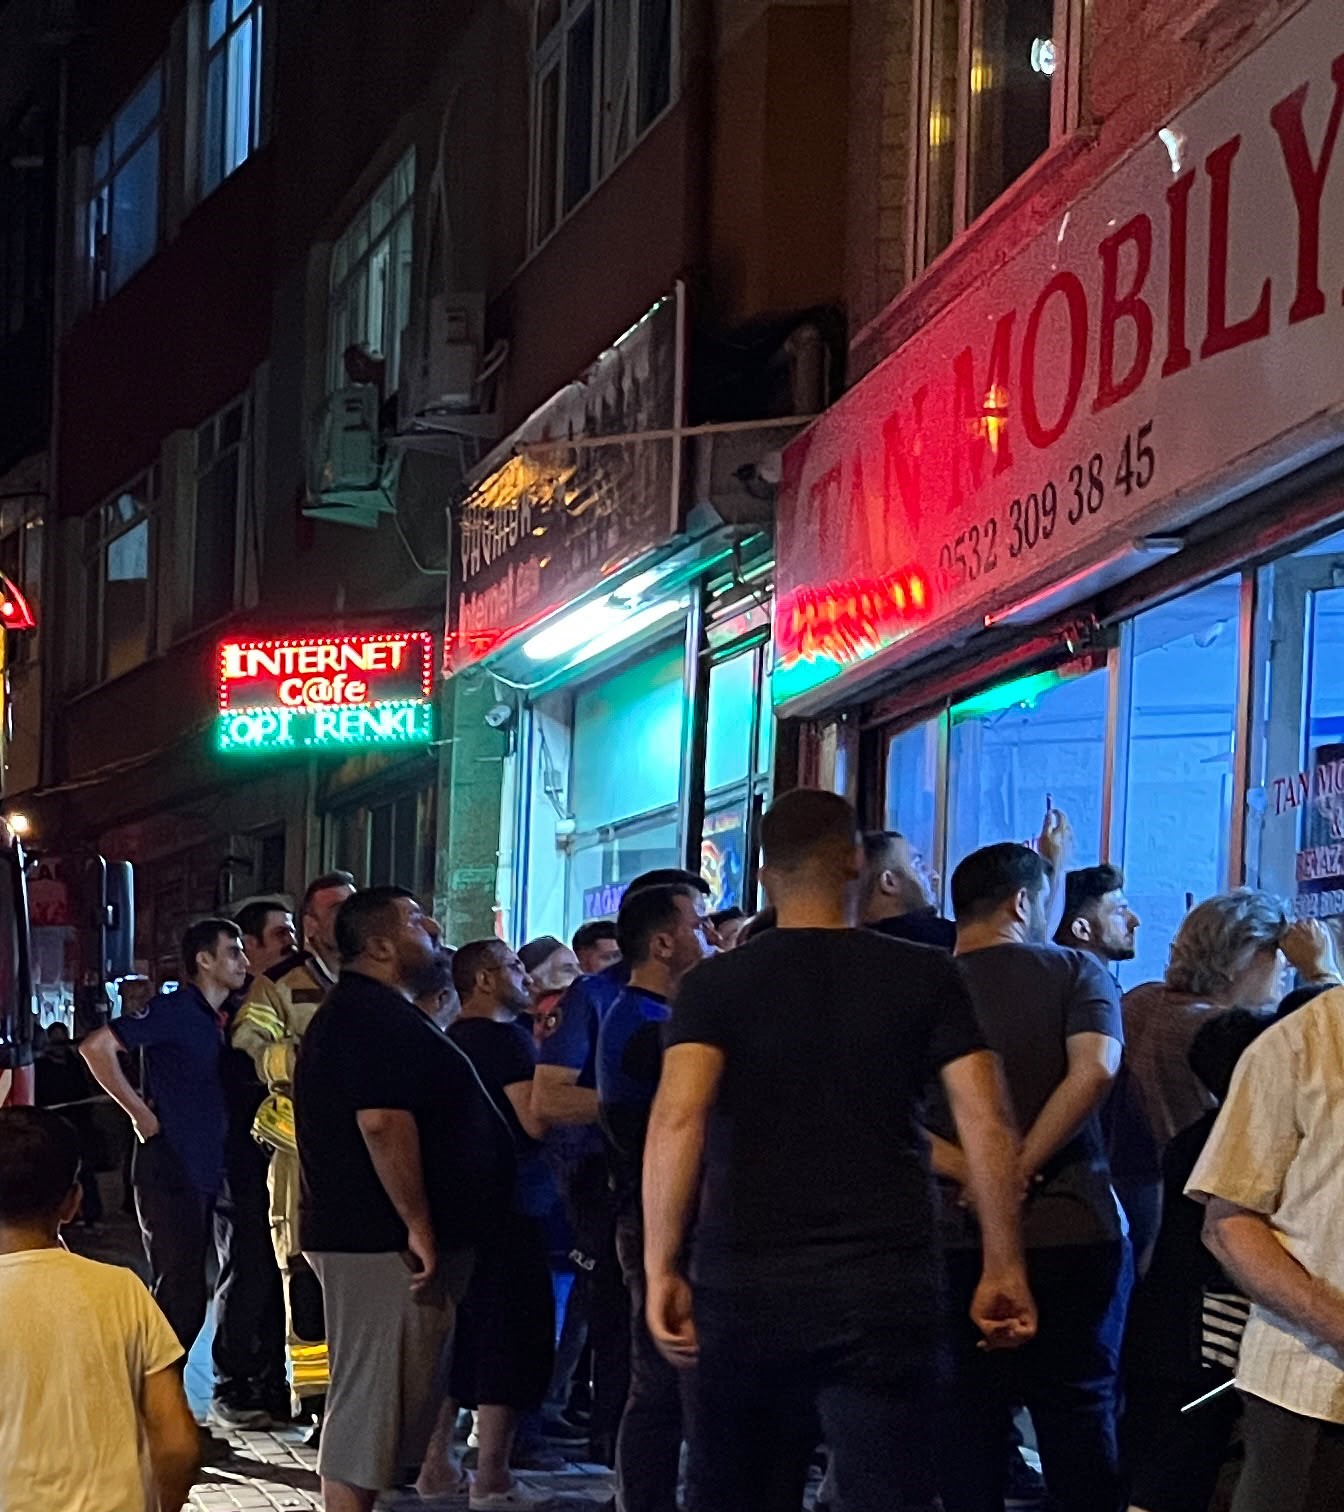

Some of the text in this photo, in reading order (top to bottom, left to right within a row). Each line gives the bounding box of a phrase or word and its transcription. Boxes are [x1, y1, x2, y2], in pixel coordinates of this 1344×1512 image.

[947, 52, 1344, 514] MOBILY
[1009, 480, 1058, 558] 309
[1068, 452, 1105, 526] 38
[1114, 419, 1155, 496] 45
[223, 641, 406, 679] INTERNET
[1273, 771, 1310, 816] TAN
